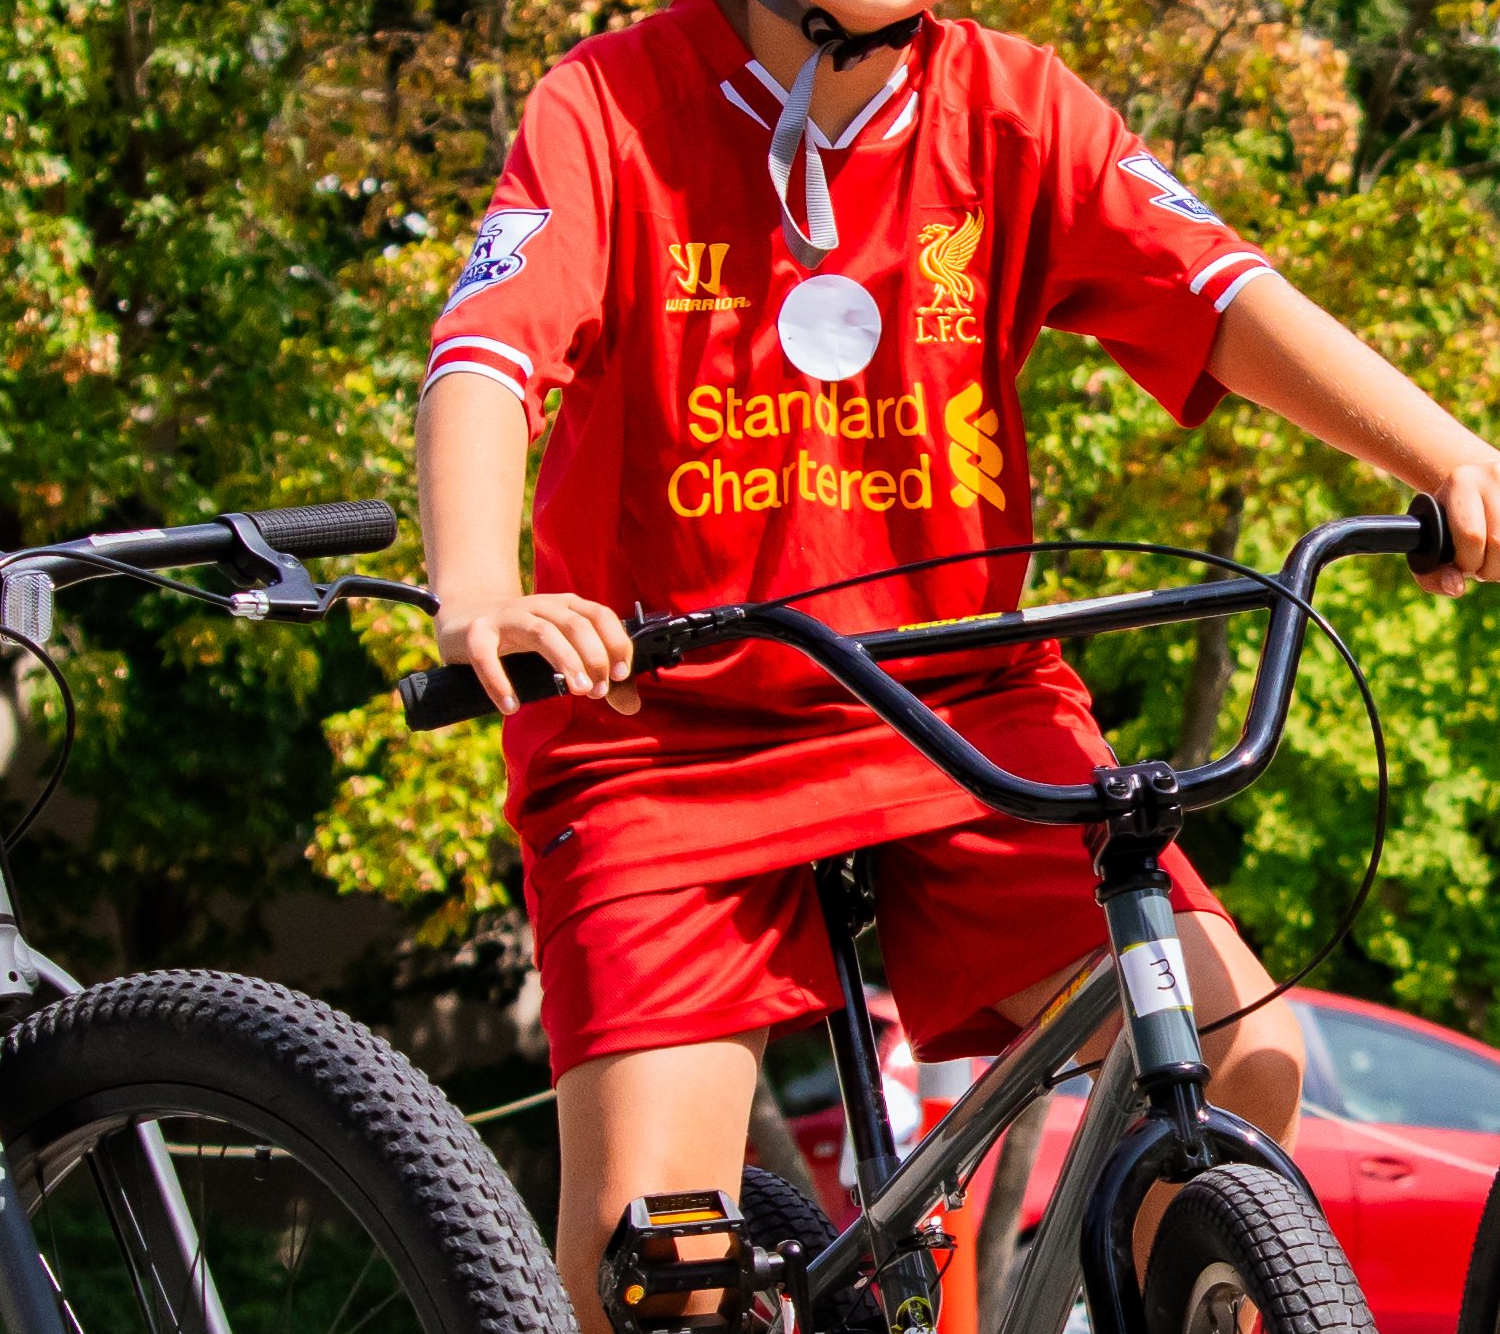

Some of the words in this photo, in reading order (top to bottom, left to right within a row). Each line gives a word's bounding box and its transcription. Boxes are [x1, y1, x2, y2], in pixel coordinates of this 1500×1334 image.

[665, 296, 746, 312] WARRIOR
[915, 316, 982, 343] L.F.C.
[688, 382, 928, 443] Standard
[668, 449, 933, 517] Chartered
[1149, 958, 1176, 990] 3
